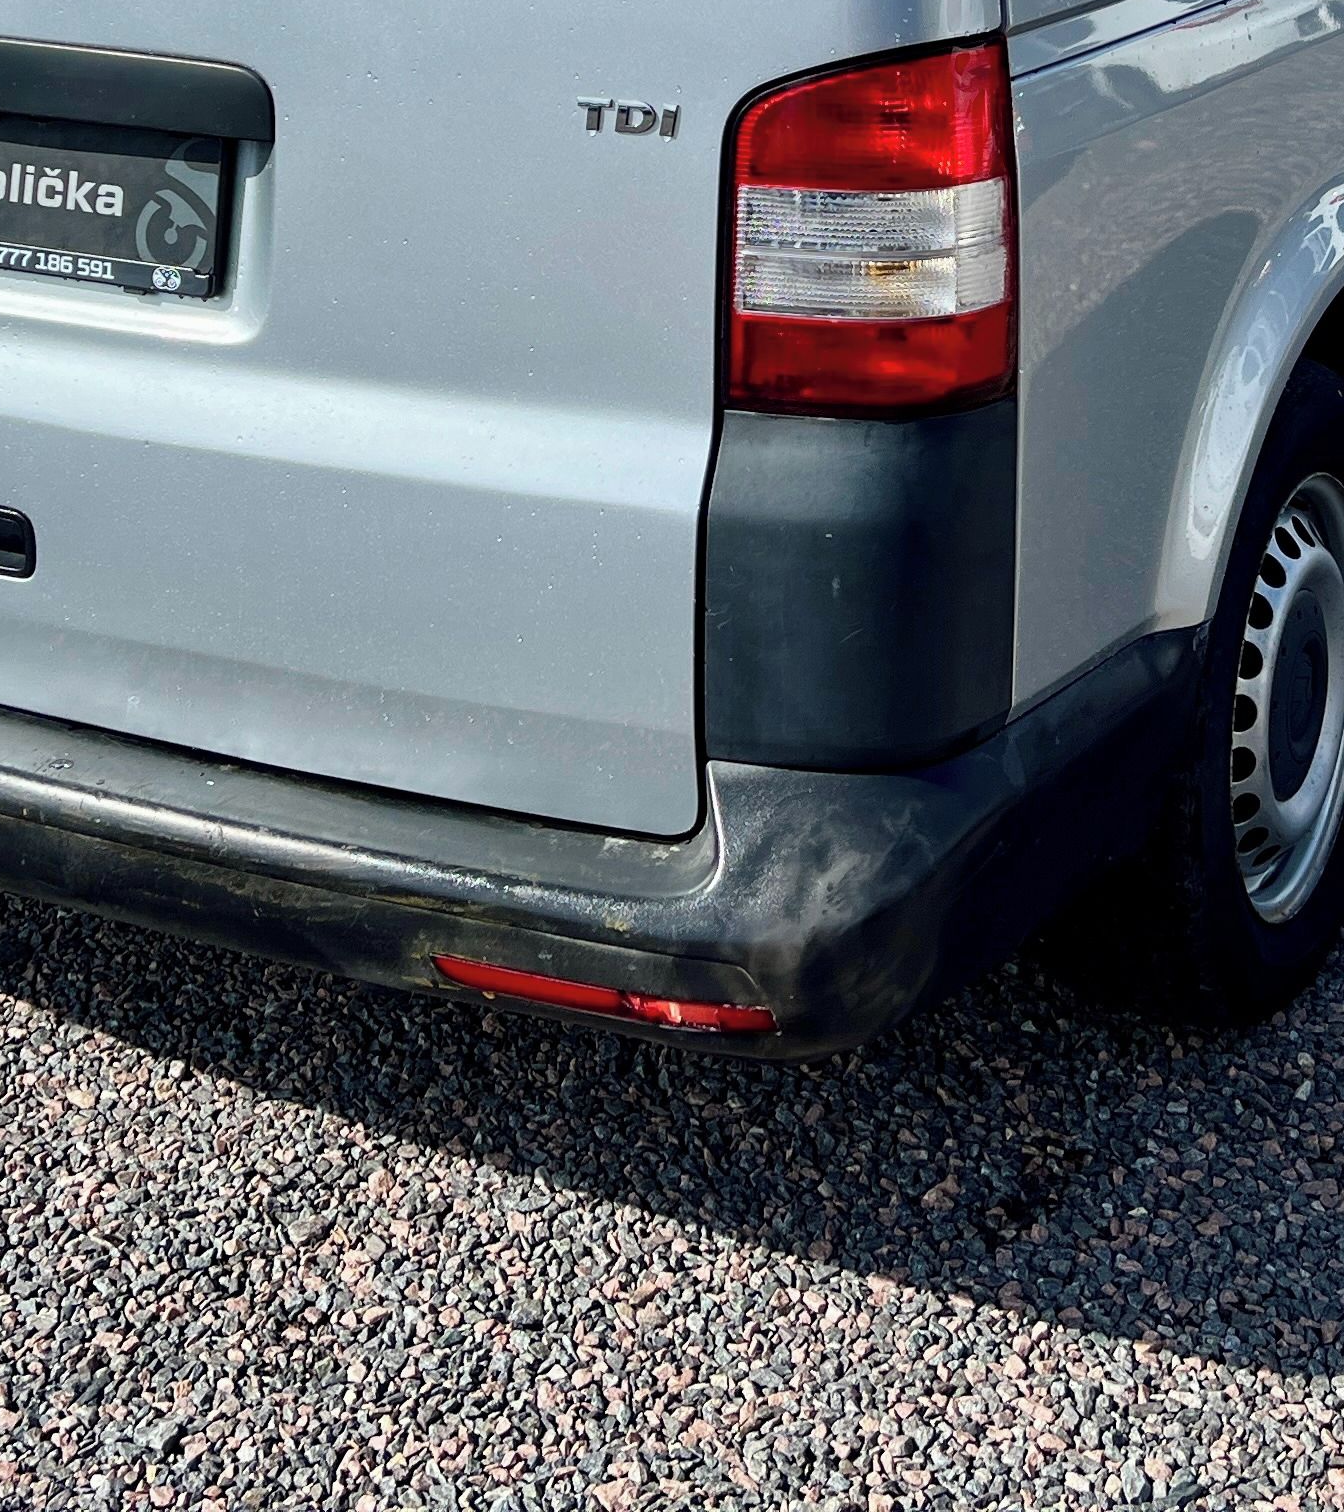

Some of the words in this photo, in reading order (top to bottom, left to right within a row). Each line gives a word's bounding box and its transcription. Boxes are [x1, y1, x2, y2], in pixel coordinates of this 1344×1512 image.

[576, 95, 681, 140] TDI
[35, 252, 74, 274] 186
[77, 258, 115, 280] 591
